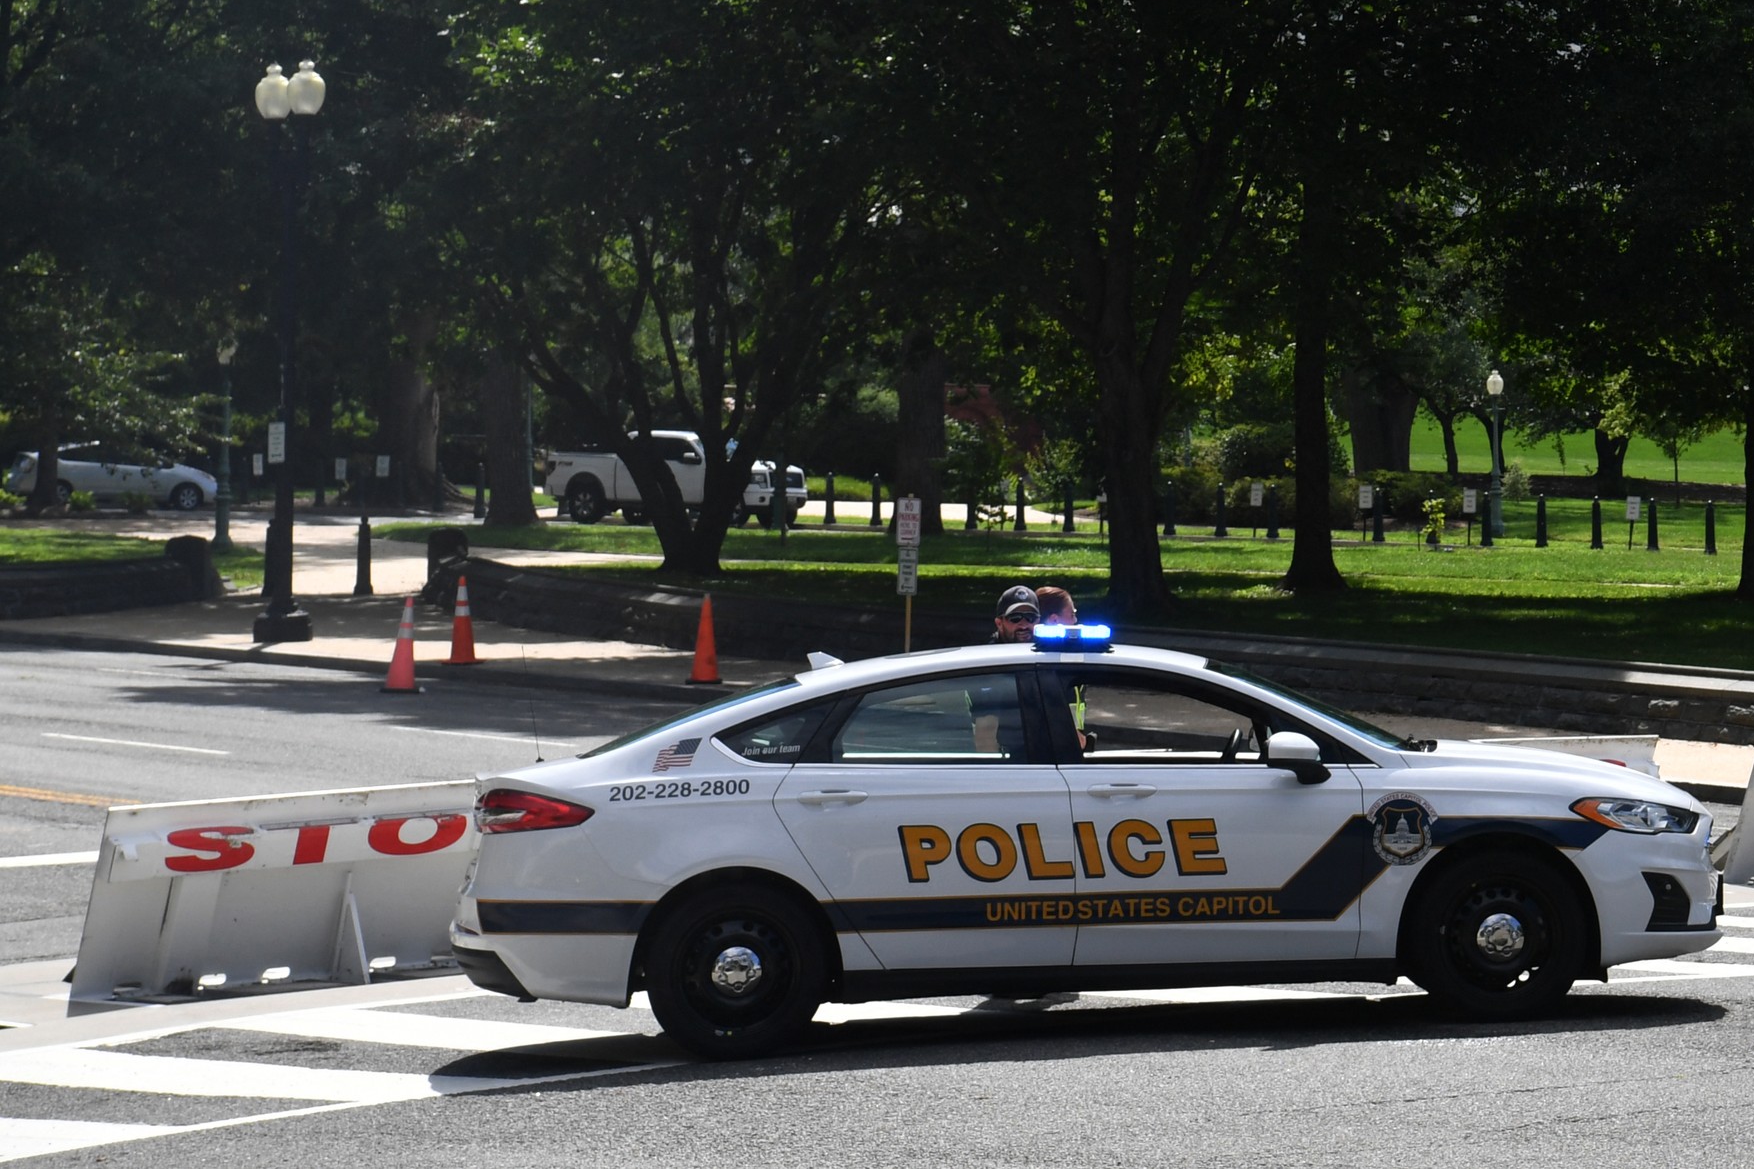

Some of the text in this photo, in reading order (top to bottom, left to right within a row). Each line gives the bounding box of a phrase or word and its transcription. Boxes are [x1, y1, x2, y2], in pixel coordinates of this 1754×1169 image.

[741, 742, 801, 757] Join our team
[609, 779, 750, 802] 202-228-2800
[165, 814, 468, 872] STO
[897, 818, 1228, 883] POLICE
[986, 896, 1281, 922] UNITED STATES CAPITOL
